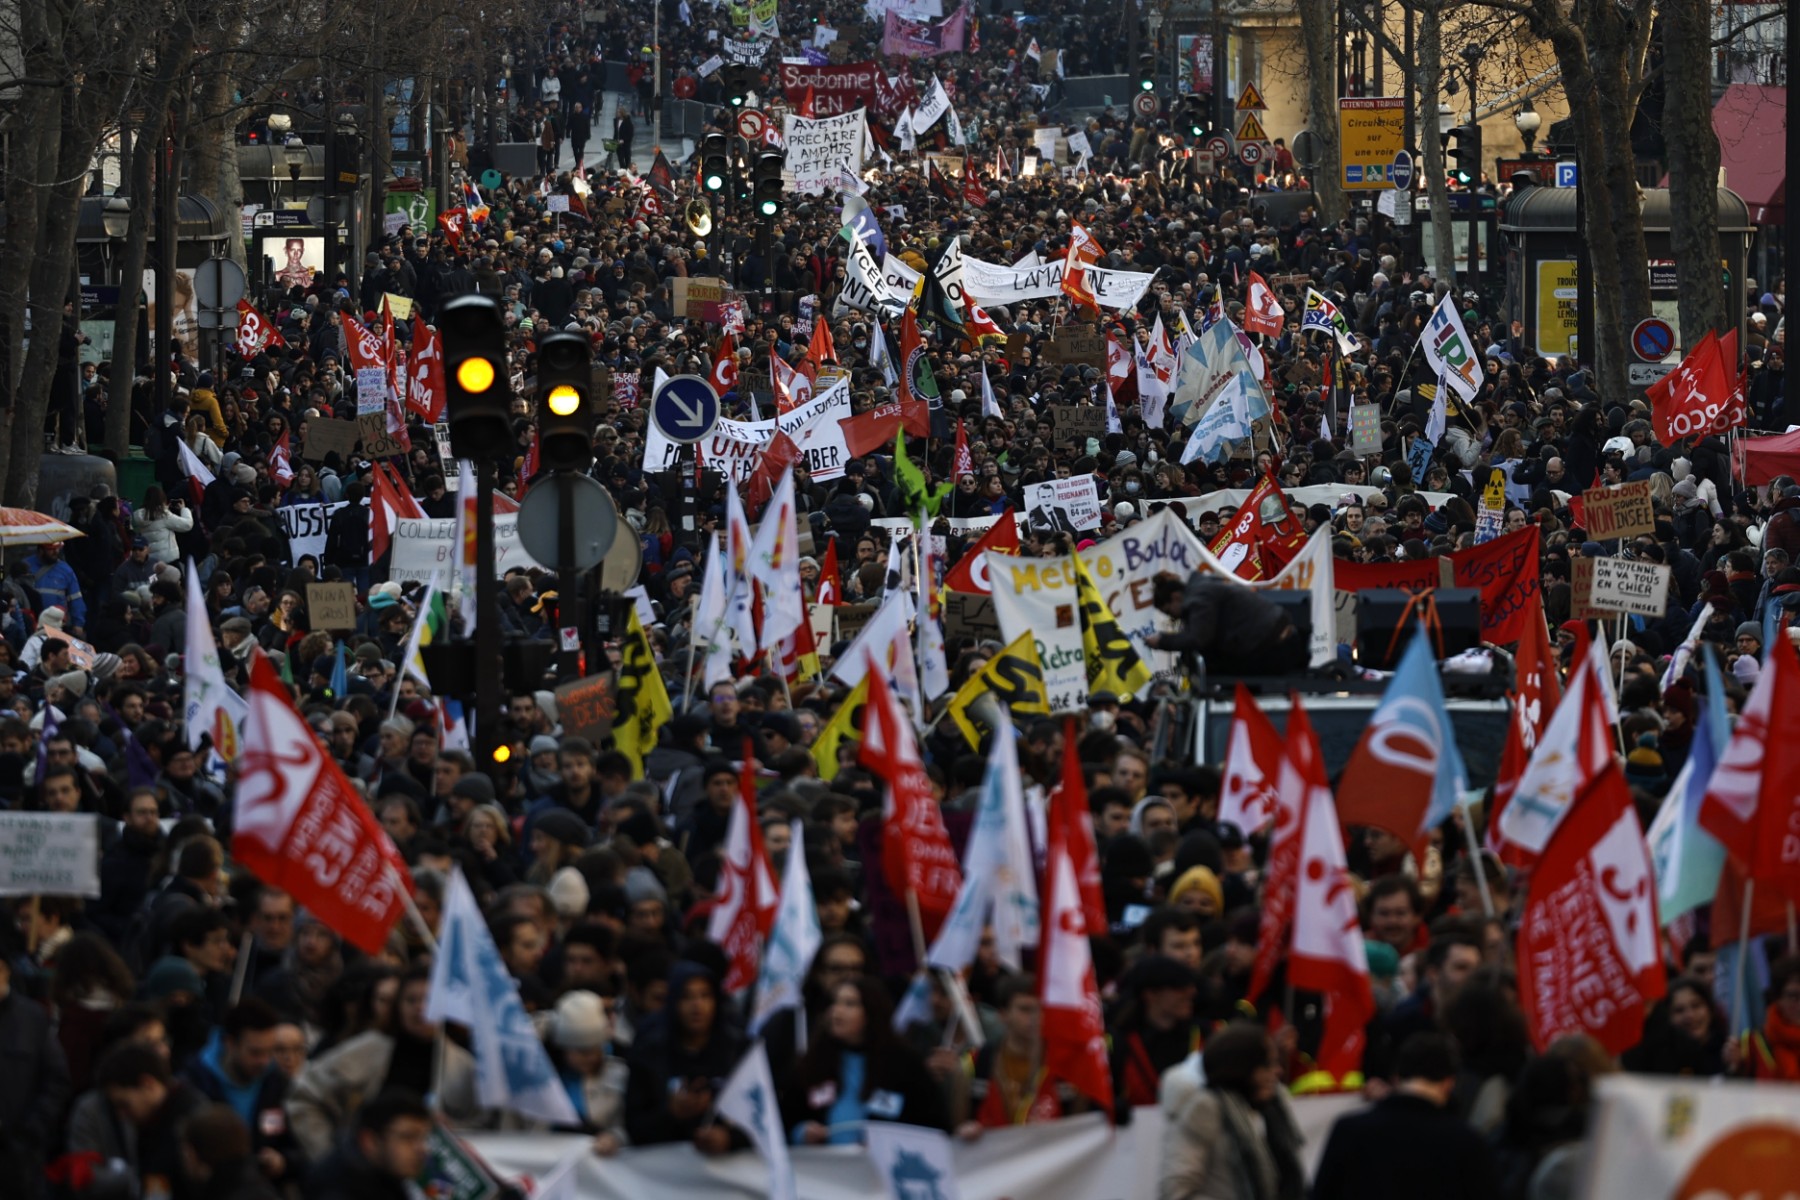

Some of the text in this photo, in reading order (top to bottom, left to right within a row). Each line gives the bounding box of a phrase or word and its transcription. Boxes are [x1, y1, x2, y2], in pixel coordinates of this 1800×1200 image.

[784, 66, 871, 89] Sorbonne
[815, 95, 843, 113] EN
[1341, 100, 1374, 109] ATTENTION
[793, 113, 859, 132] AVENIR
[1348, 118, 1400, 128] Circulation
[1366, 134, 1381, 142] sur
[1245, 149, 1258, 158] 30
[1375, 148, 1394, 156] voie
[1563, 168, 1574, 183] P
[687, 287, 720, 300] MOURIR
[409, 376, 433, 413] NPA
[1057, 488, 1090, 501] FEIGNANTS
[1583, 481, 1649, 503] TOUJOURS
[1070, 508, 1080, 517] 64
[1585, 504, 1653, 536] NON INSEE
[1598, 559, 1657, 575] EN MOYENNE
[1597, 569, 1660, 585] ON VA TOUS
[1597, 580, 1612, 589] EN
[1631, 602, 1658, 613] INSEE
